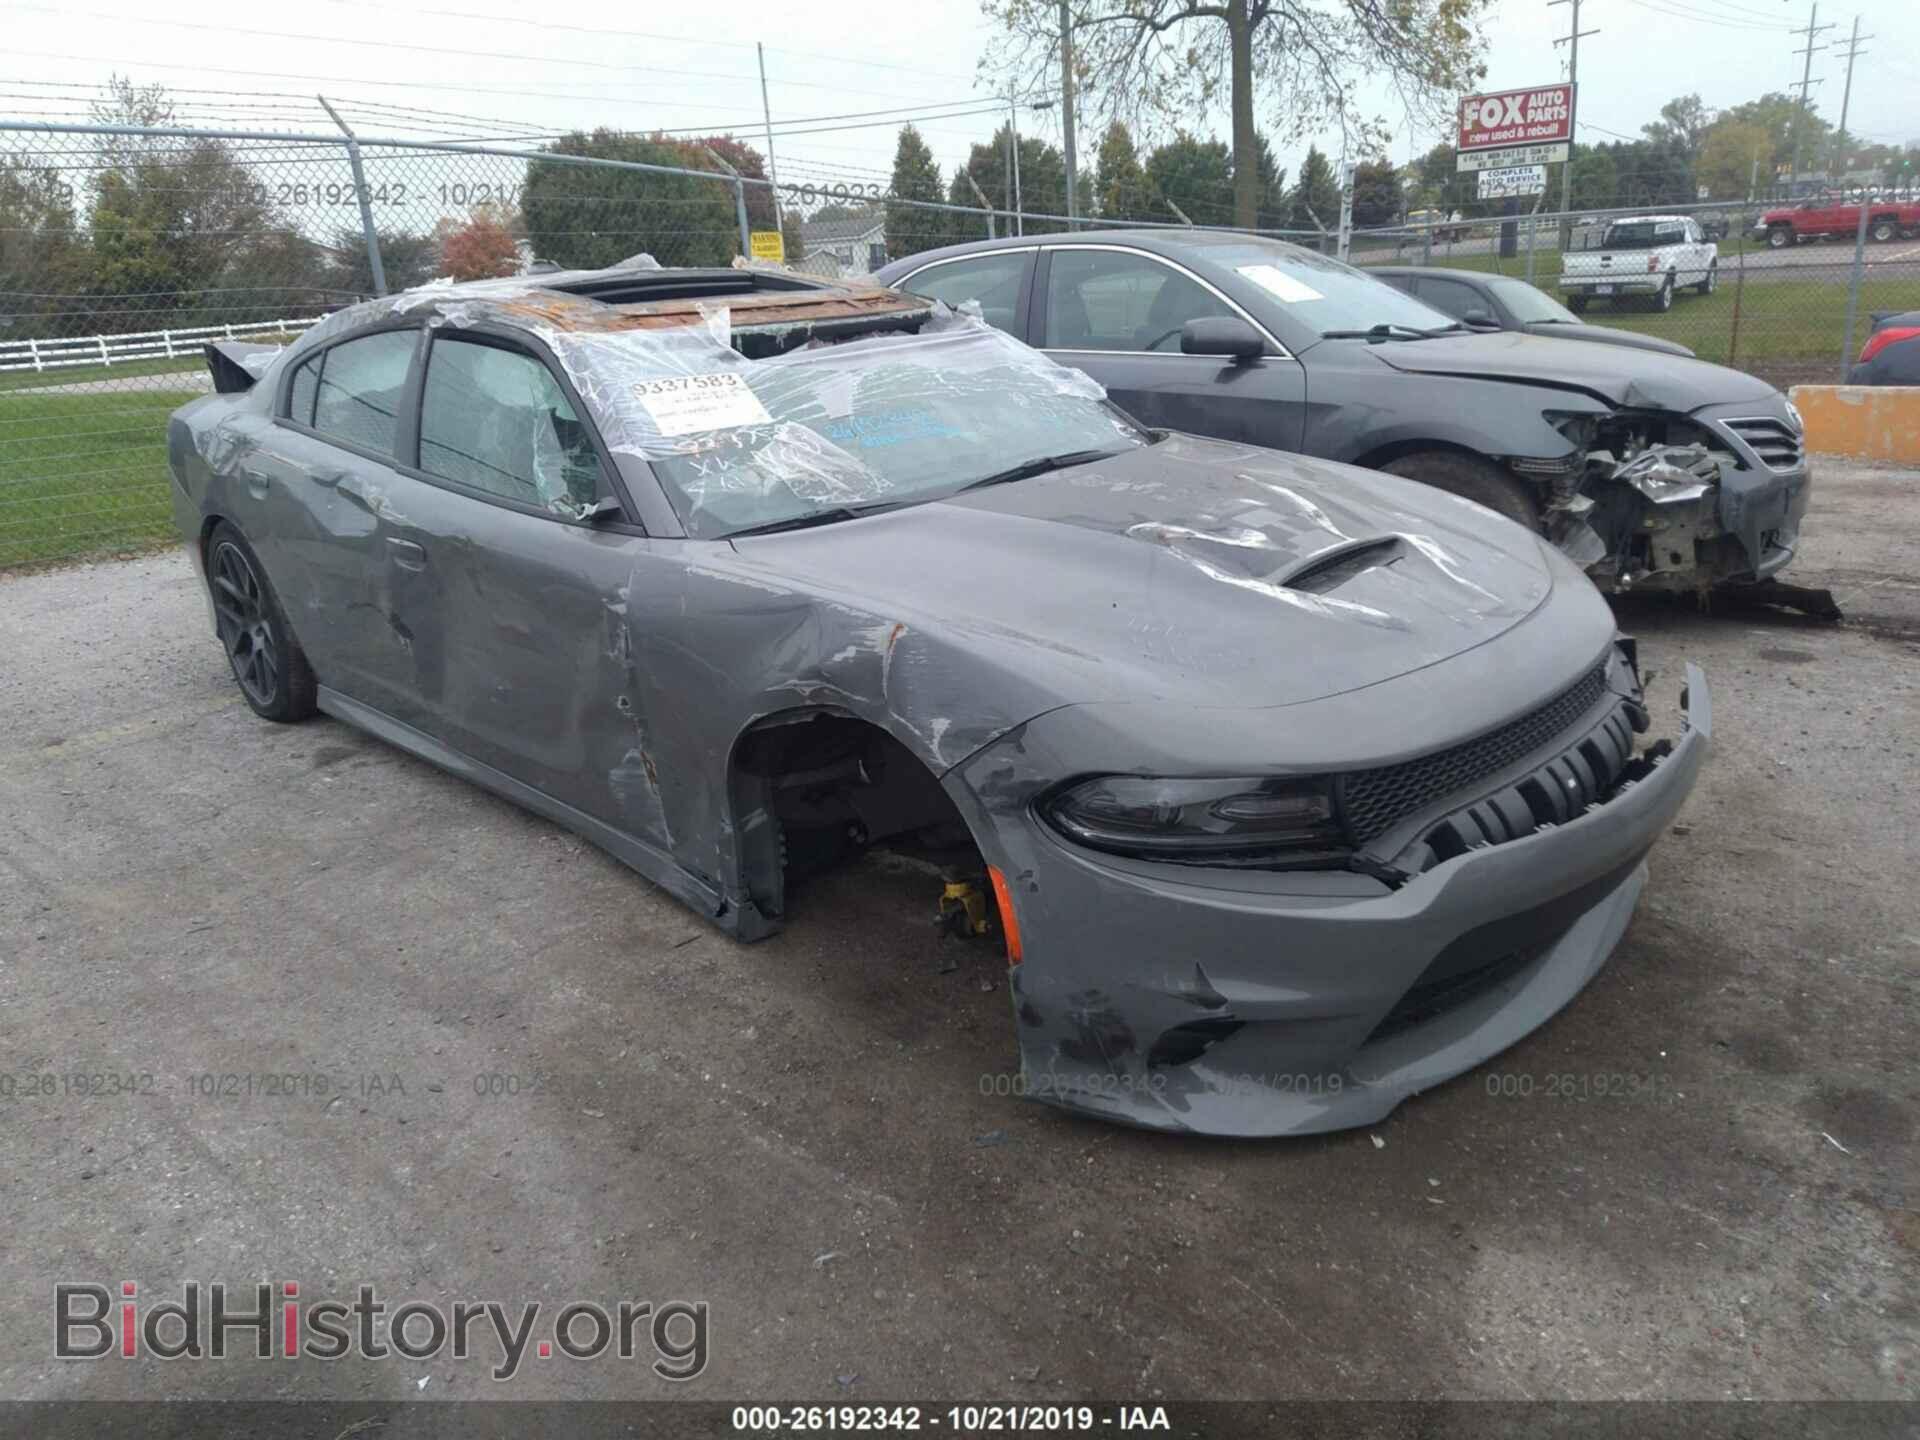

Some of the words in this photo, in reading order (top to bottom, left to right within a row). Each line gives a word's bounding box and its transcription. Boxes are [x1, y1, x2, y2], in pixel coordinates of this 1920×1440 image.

[1528, 90, 1564, 108] AUTO
[1463, 95, 1525, 131] FOX
[1527, 105, 1567, 123] PARTS
[1469, 134, 1489, 143] new
[1491, 130, 1515, 141] used
[1527, 122, 1558, 137] rebuilt
[1480, 177, 1503, 185] AUTO
[1507, 174, 1541, 183] SERVICE
[1487, 168, 1533, 177] COMPLETE
[632, 374, 737, 396] 9337583
